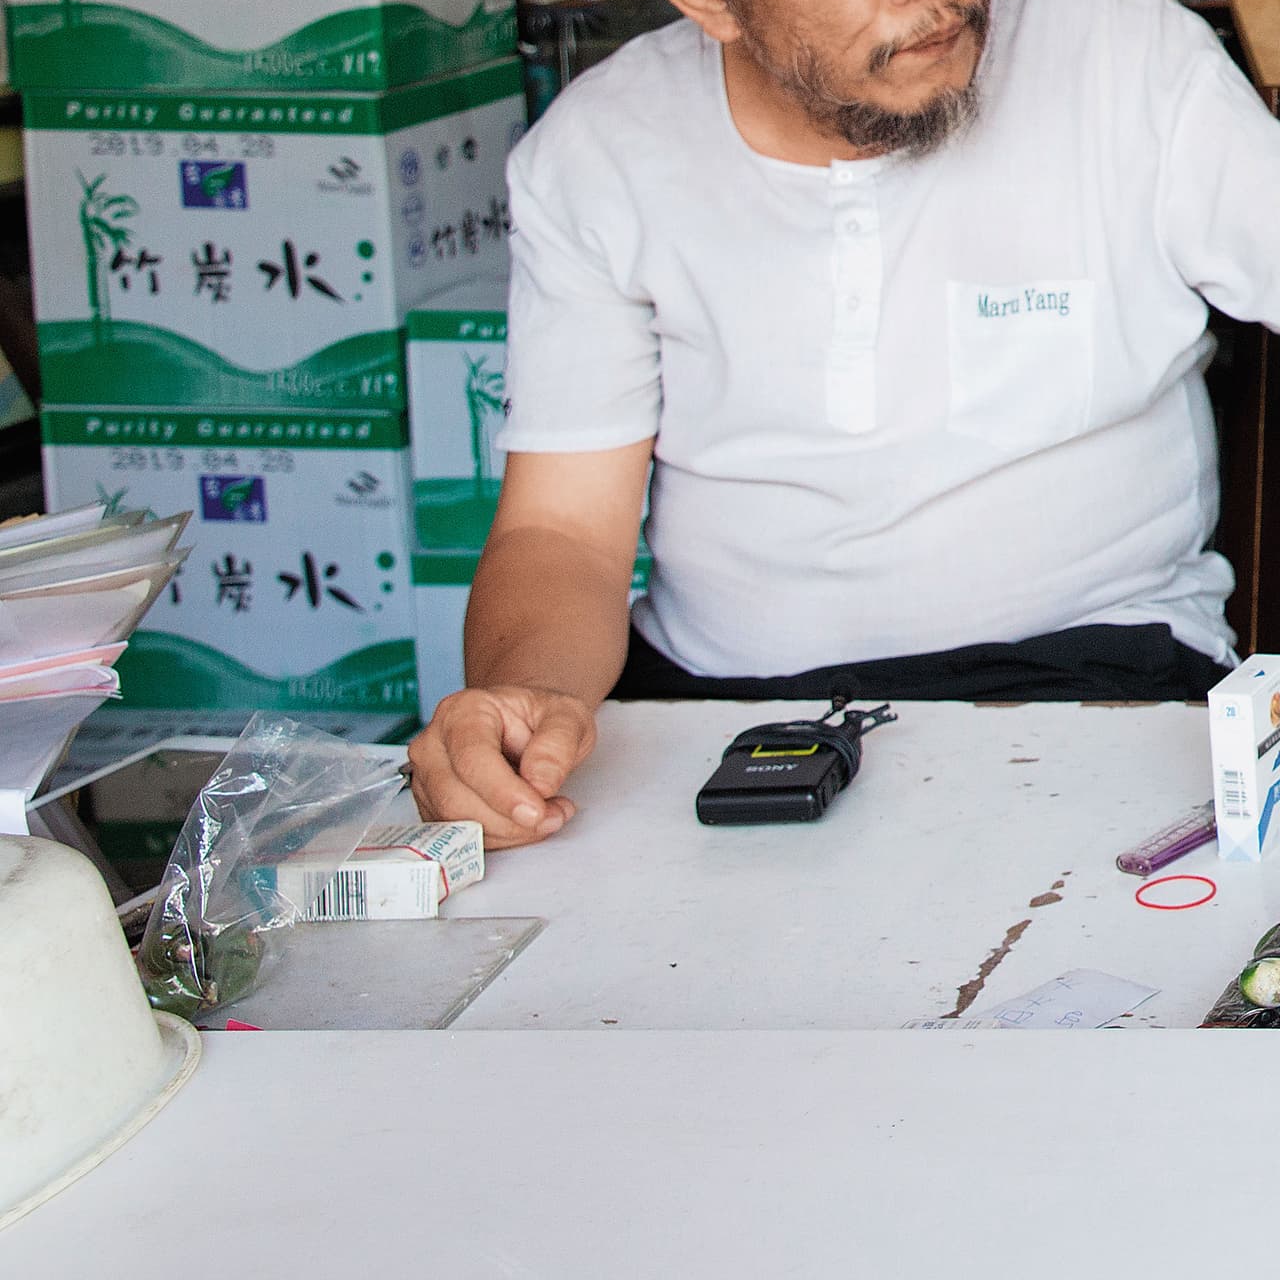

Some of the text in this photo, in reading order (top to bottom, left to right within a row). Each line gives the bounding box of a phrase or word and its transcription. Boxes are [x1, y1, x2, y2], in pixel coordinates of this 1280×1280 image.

[66, 101, 354, 123] Purity Guaranteed
[111, 239, 348, 303] 竹炭水
[977, 287, 1070, 318] Maru Yang
[86, 419, 371, 441] Purity Guaranteed
